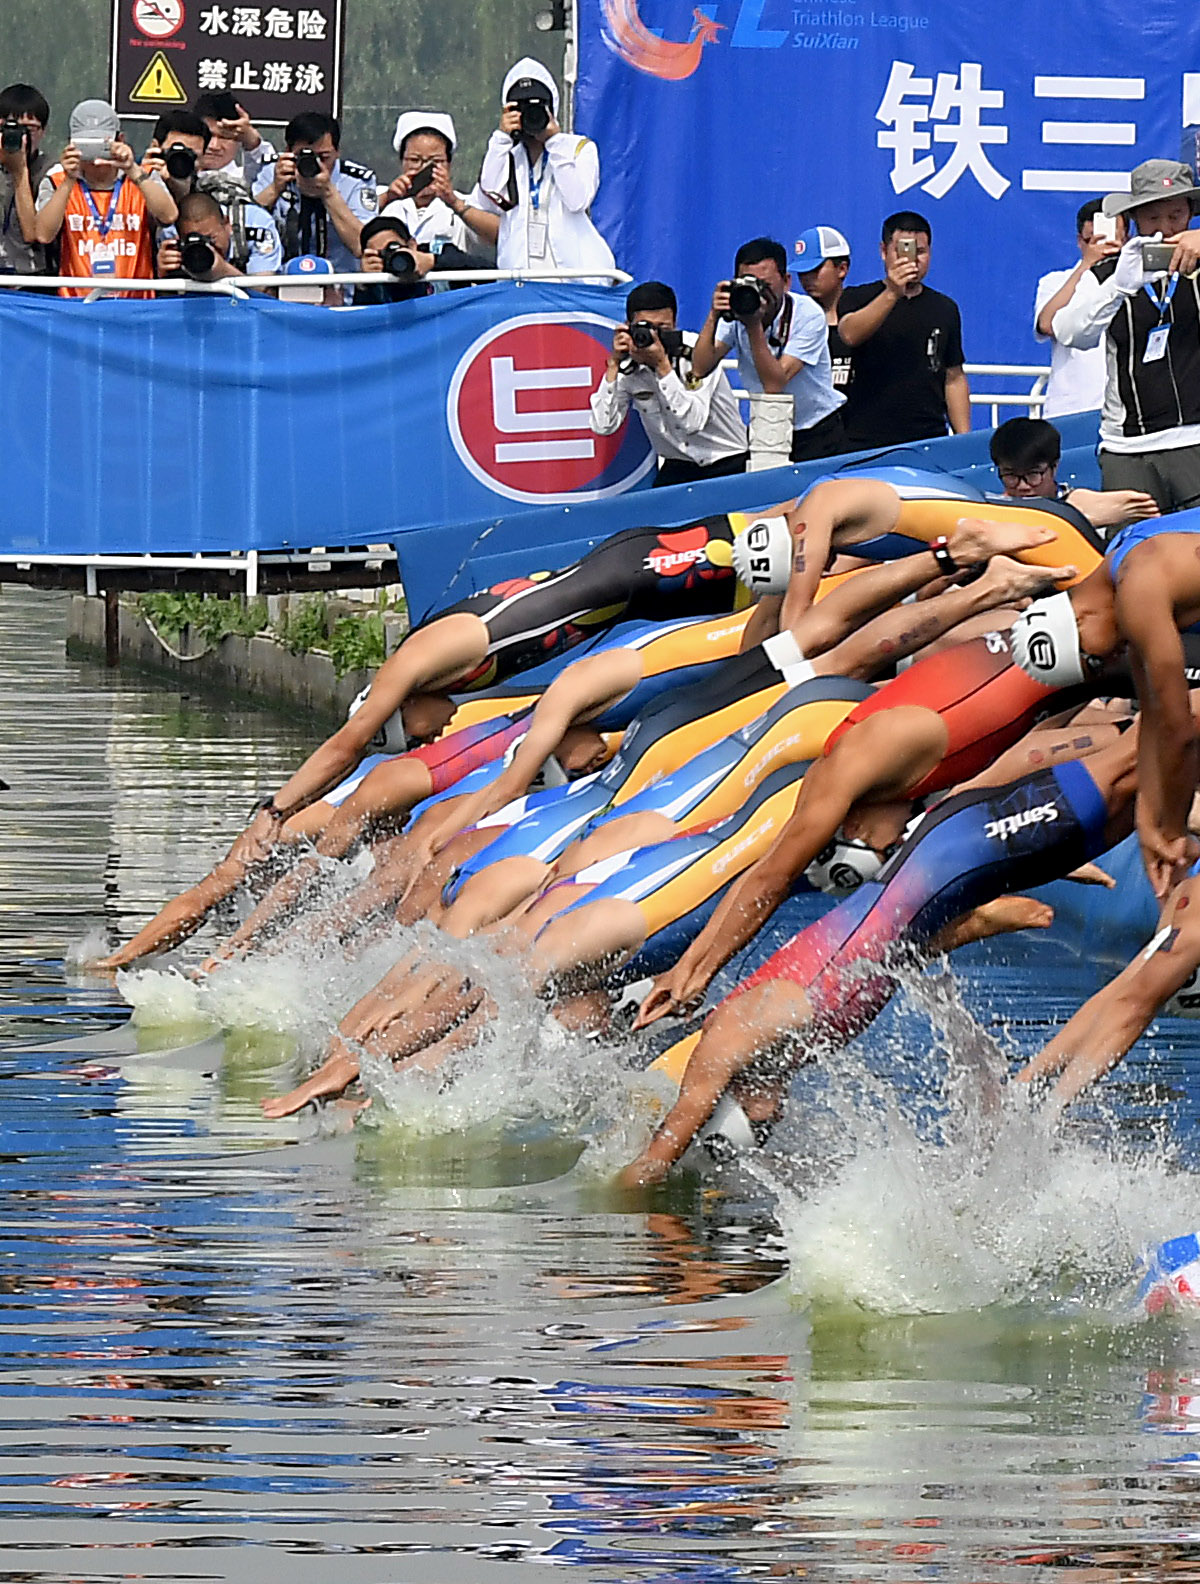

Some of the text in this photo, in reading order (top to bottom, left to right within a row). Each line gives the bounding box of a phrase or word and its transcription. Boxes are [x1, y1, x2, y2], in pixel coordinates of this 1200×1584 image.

[199, 5, 328, 40] 水深危险
[791, 9, 865, 27] Triathlon
[870, 11, 930, 33] League
[791, 32, 860, 50] SuiXian
[198, 58, 325, 95] 禁止游泳
[983, 801, 1058, 841] Santic
